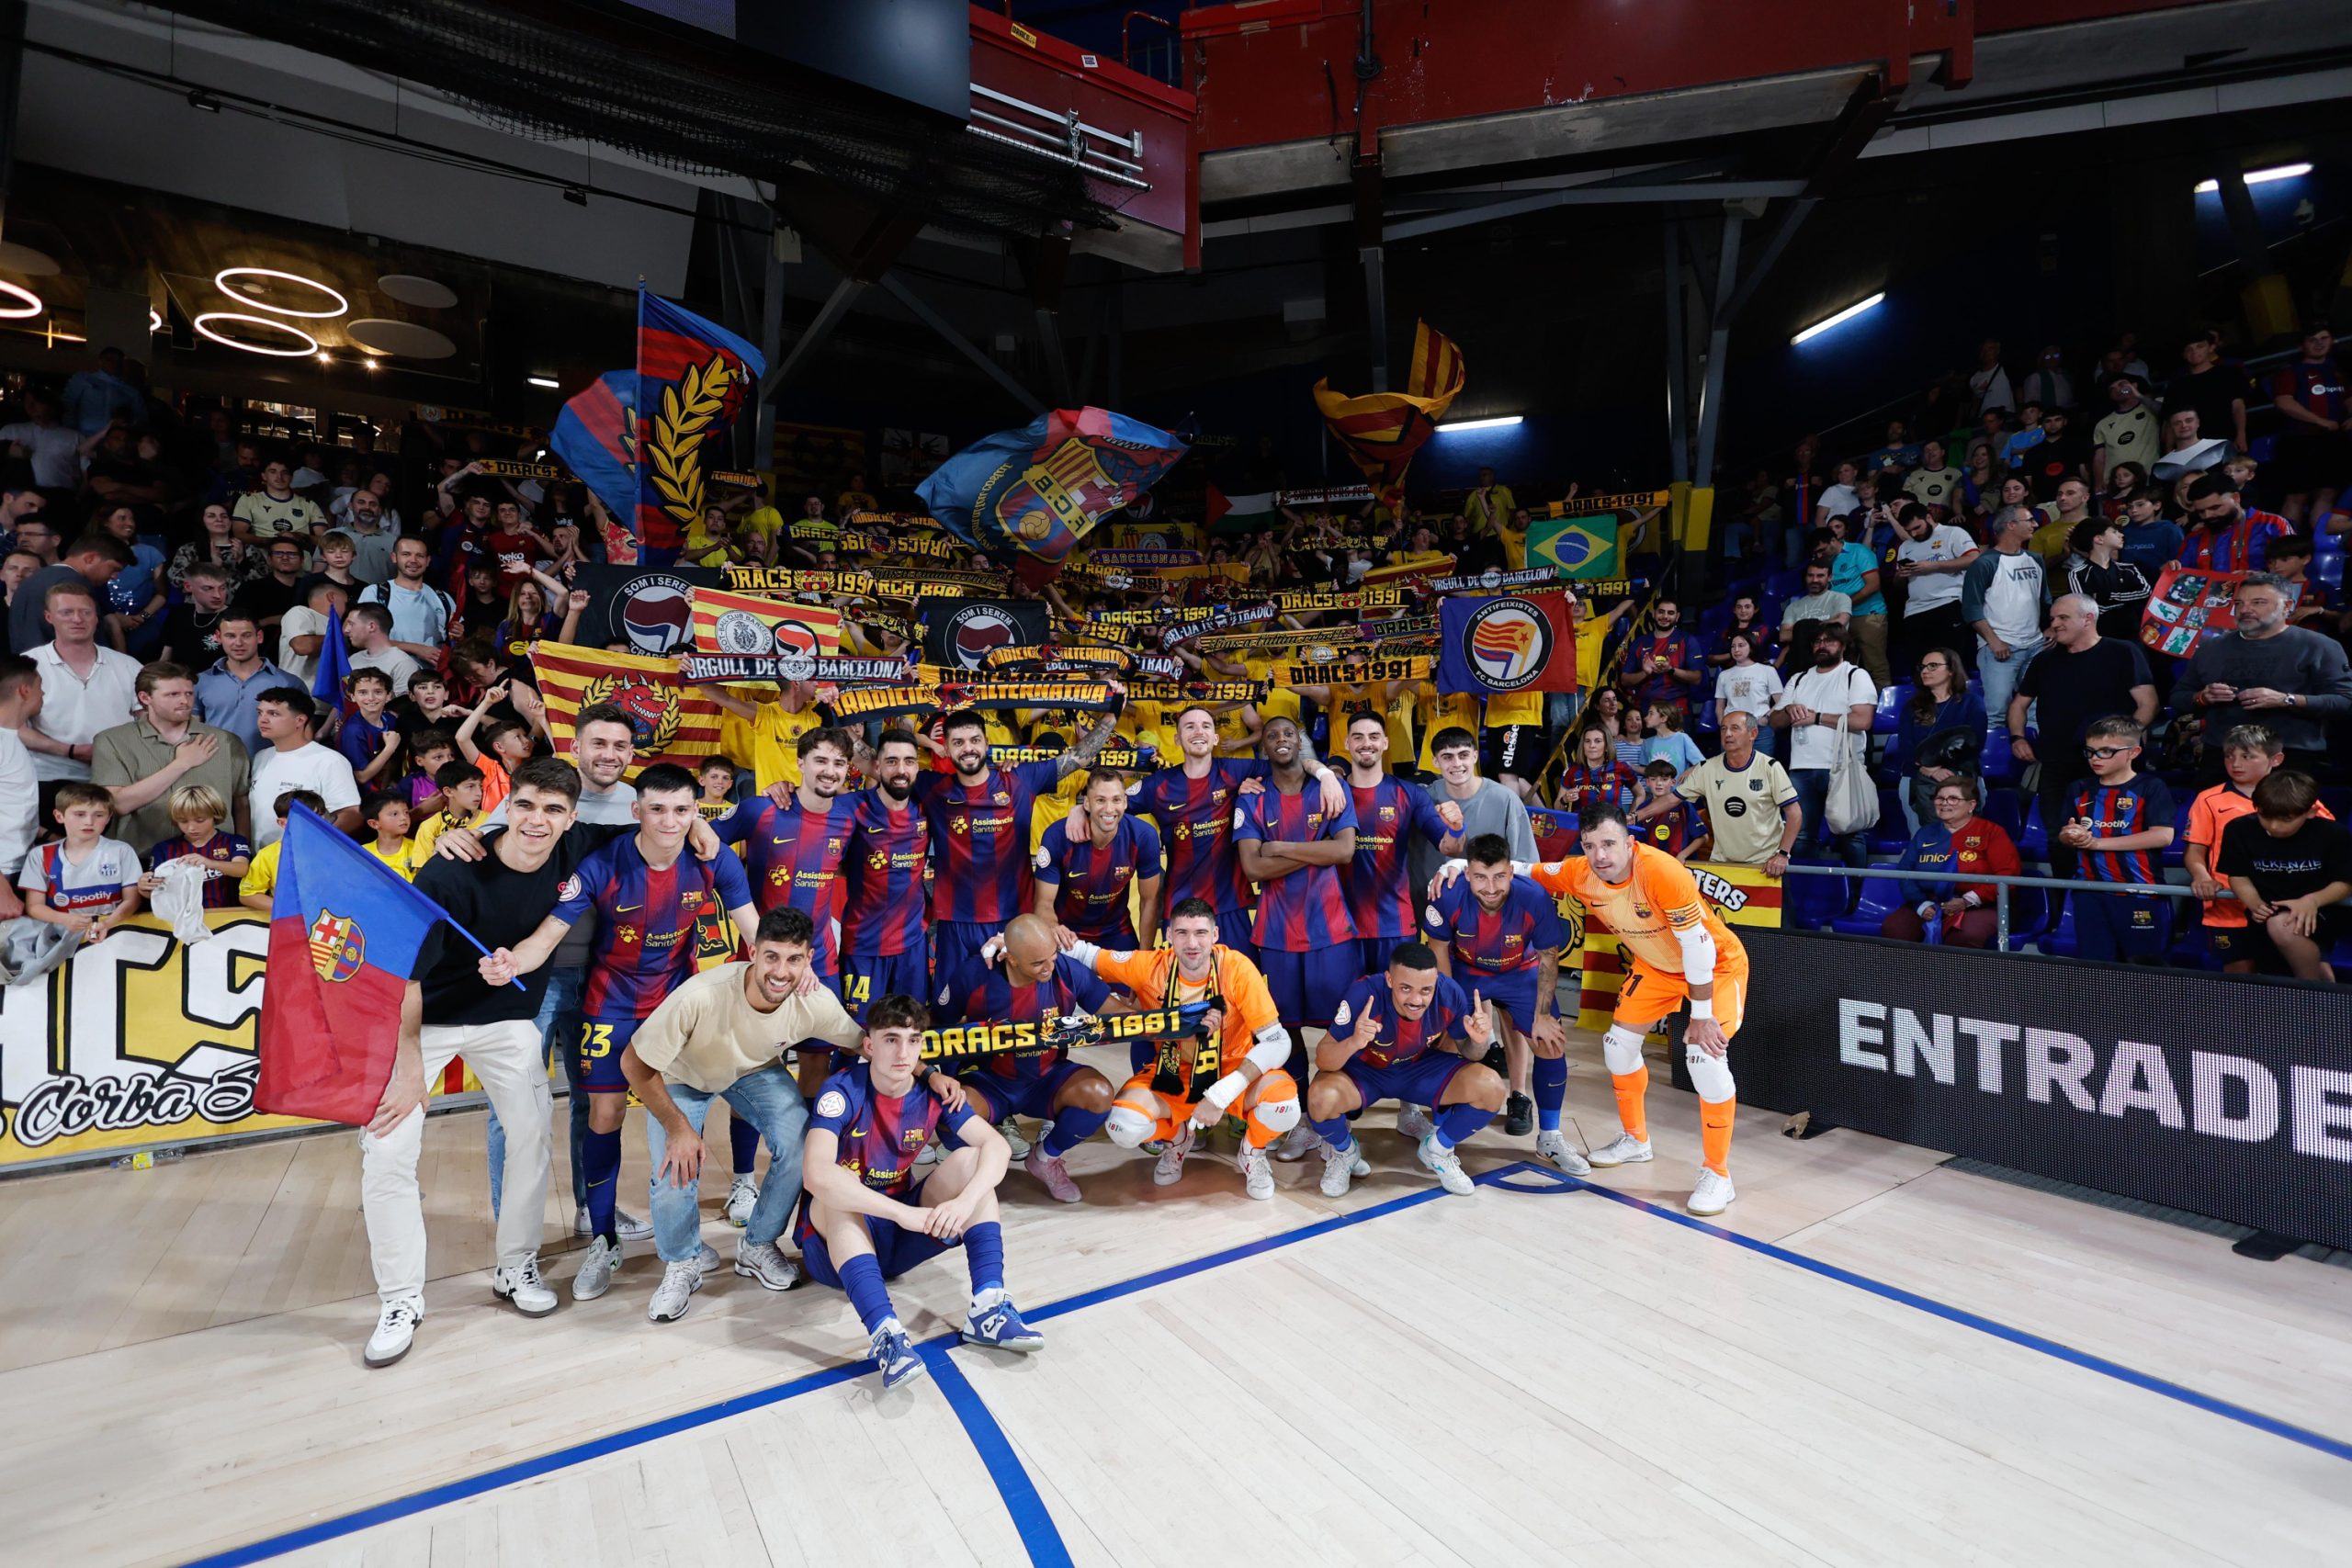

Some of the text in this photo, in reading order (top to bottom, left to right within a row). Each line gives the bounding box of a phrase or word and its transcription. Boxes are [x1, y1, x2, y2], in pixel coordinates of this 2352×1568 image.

[496, 462, 551, 477] DRACS
[1616, 494, 1654, 507] 1991
[498, 552, 525, 563] beko
[1102, 555, 1178, 565] BARCELONA
[1431, 566, 1555, 590] ORGULL DE BARCELONA
[2007, 567, 2038, 581] VANS
[624, 578, 649, 596] SOM
[1597, 581, 1631, 596] 1991
[1281, 590, 1402, 611] DRACS 1991
[956, 611, 977, 625] SOM
[982, 607, 1012, 626] SEREM
[1101, 606, 1215, 624] DRACS 1991
[1476, 601, 1540, 621] ANTIFEIXISTES
[1091, 621, 1129, 643] 1991
[1374, 615, 1431, 637] DRACS
[689, 655, 903, 680] ORGULL DE BARCELONA
[1289, 658, 1412, 685] DRACS 1991
[1476, 670, 1540, 688] FC BARCELONA
[978, 683, 1108, 705] ALTERNATIVA
[1216, 683, 1253, 701] 1991
[1502, 724, 1520, 768] ellesse
[991, 748, 1060, 763] DRACS
[1100, 750, 1138, 768] 1991
[2094, 819, 2131, 829] Spotify
[73, 890, 112, 903] Spotify
[843, 974, 871, 1003] 14
[581, 1022, 615, 1057] 23
[920, 1010, 1182, 1060] DRACS 1991
